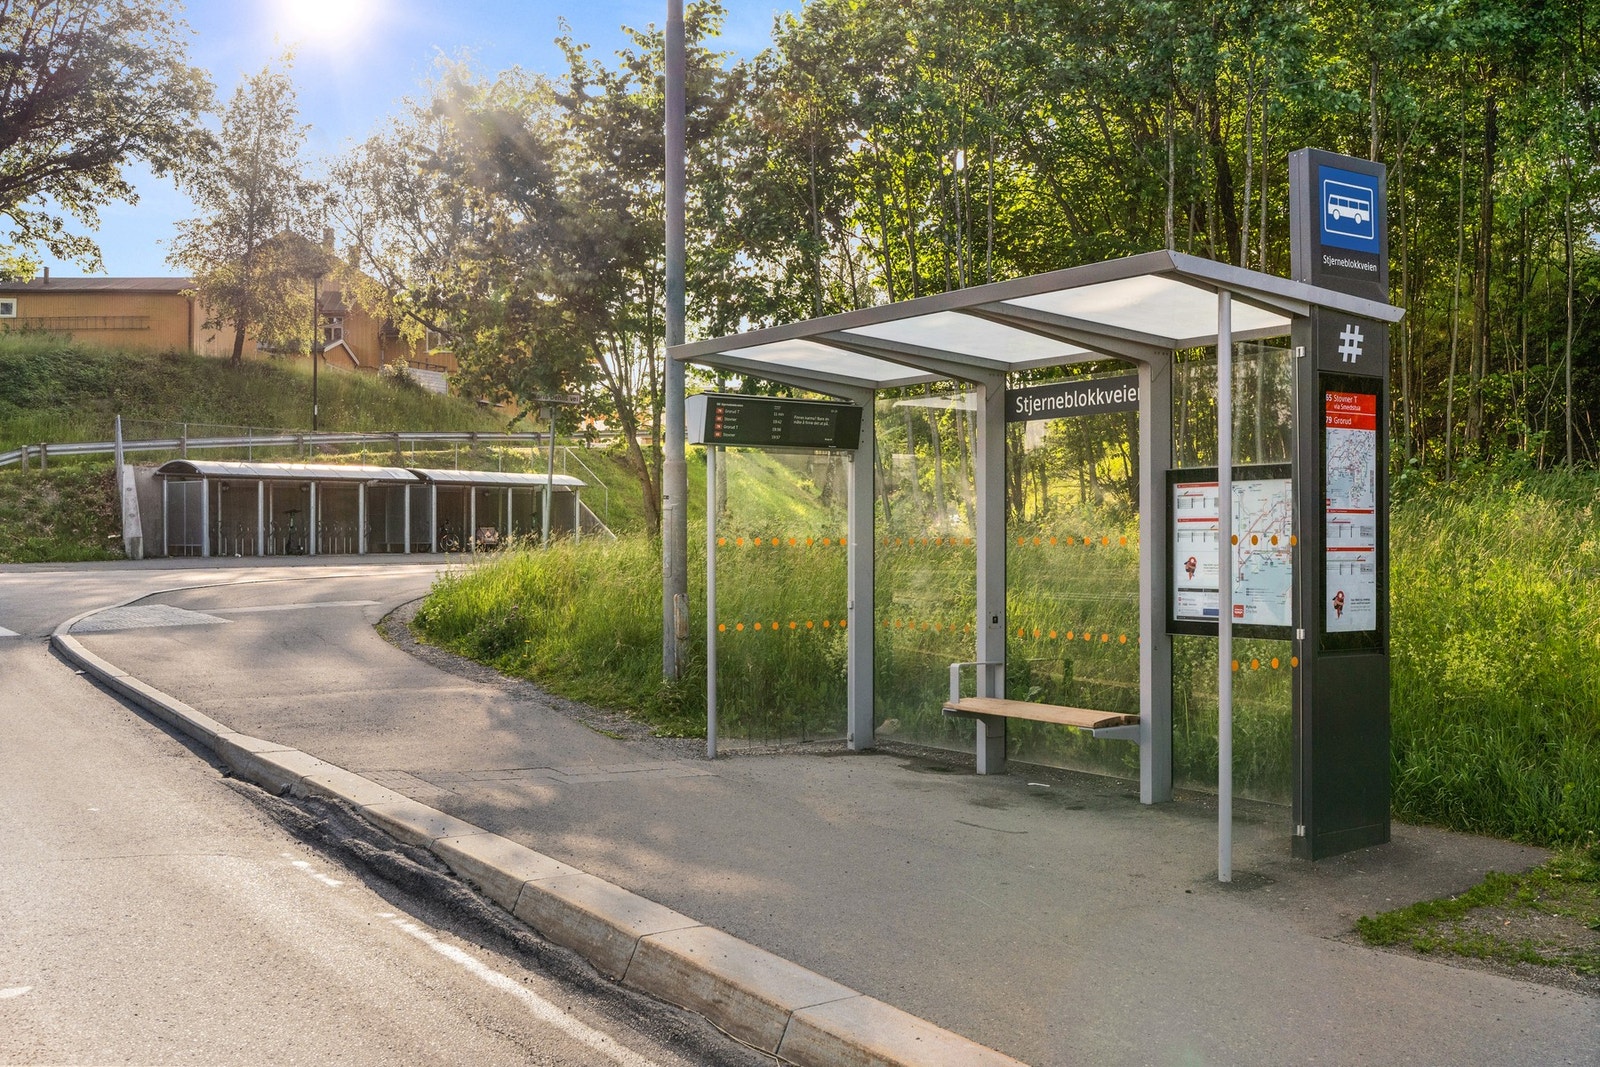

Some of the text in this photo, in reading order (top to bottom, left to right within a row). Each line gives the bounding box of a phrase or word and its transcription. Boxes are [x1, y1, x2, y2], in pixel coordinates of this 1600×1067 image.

[1323, 255, 1377, 271] Stjerneblokkveien
[1333, 395, 1353, 403] Stovner
[1333, 416, 1352, 426] Grorud
